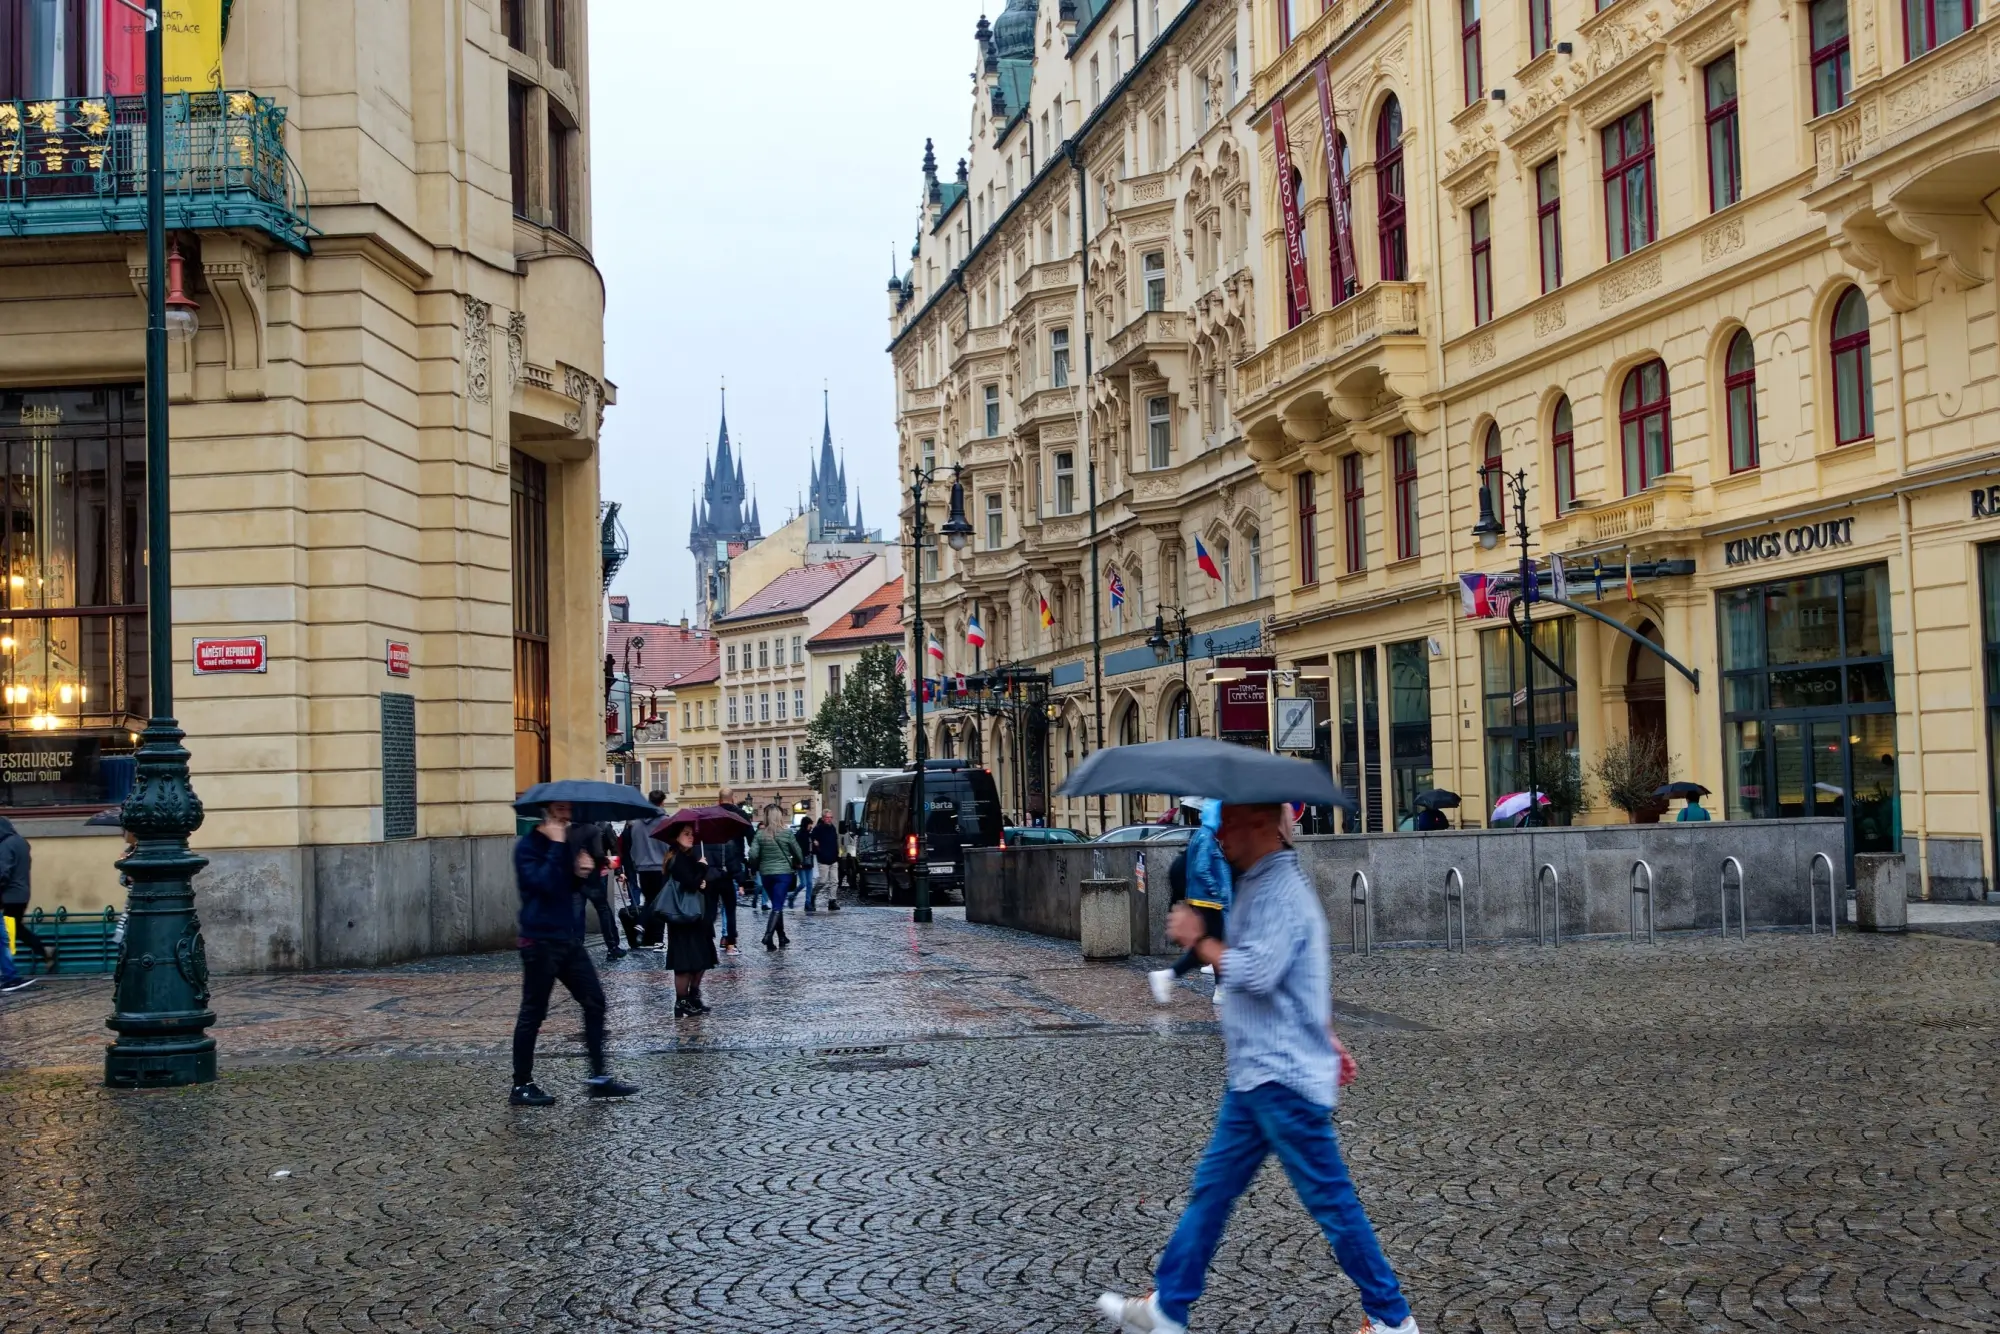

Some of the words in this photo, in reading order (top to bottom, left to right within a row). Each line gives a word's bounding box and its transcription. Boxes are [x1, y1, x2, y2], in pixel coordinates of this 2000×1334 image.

[1324, 116, 1336, 173] COURT
[1279, 152, 1292, 207] COURT
[1333, 177, 1345, 235] KINGS
[1285, 210, 1300, 267] KINGS
[1724, 532, 1781, 566] KINGS
[1784, 517, 1855, 554] COURT
[226, 646, 256, 657] REPUBLIKY
[930, 801, 953, 809] Barta
